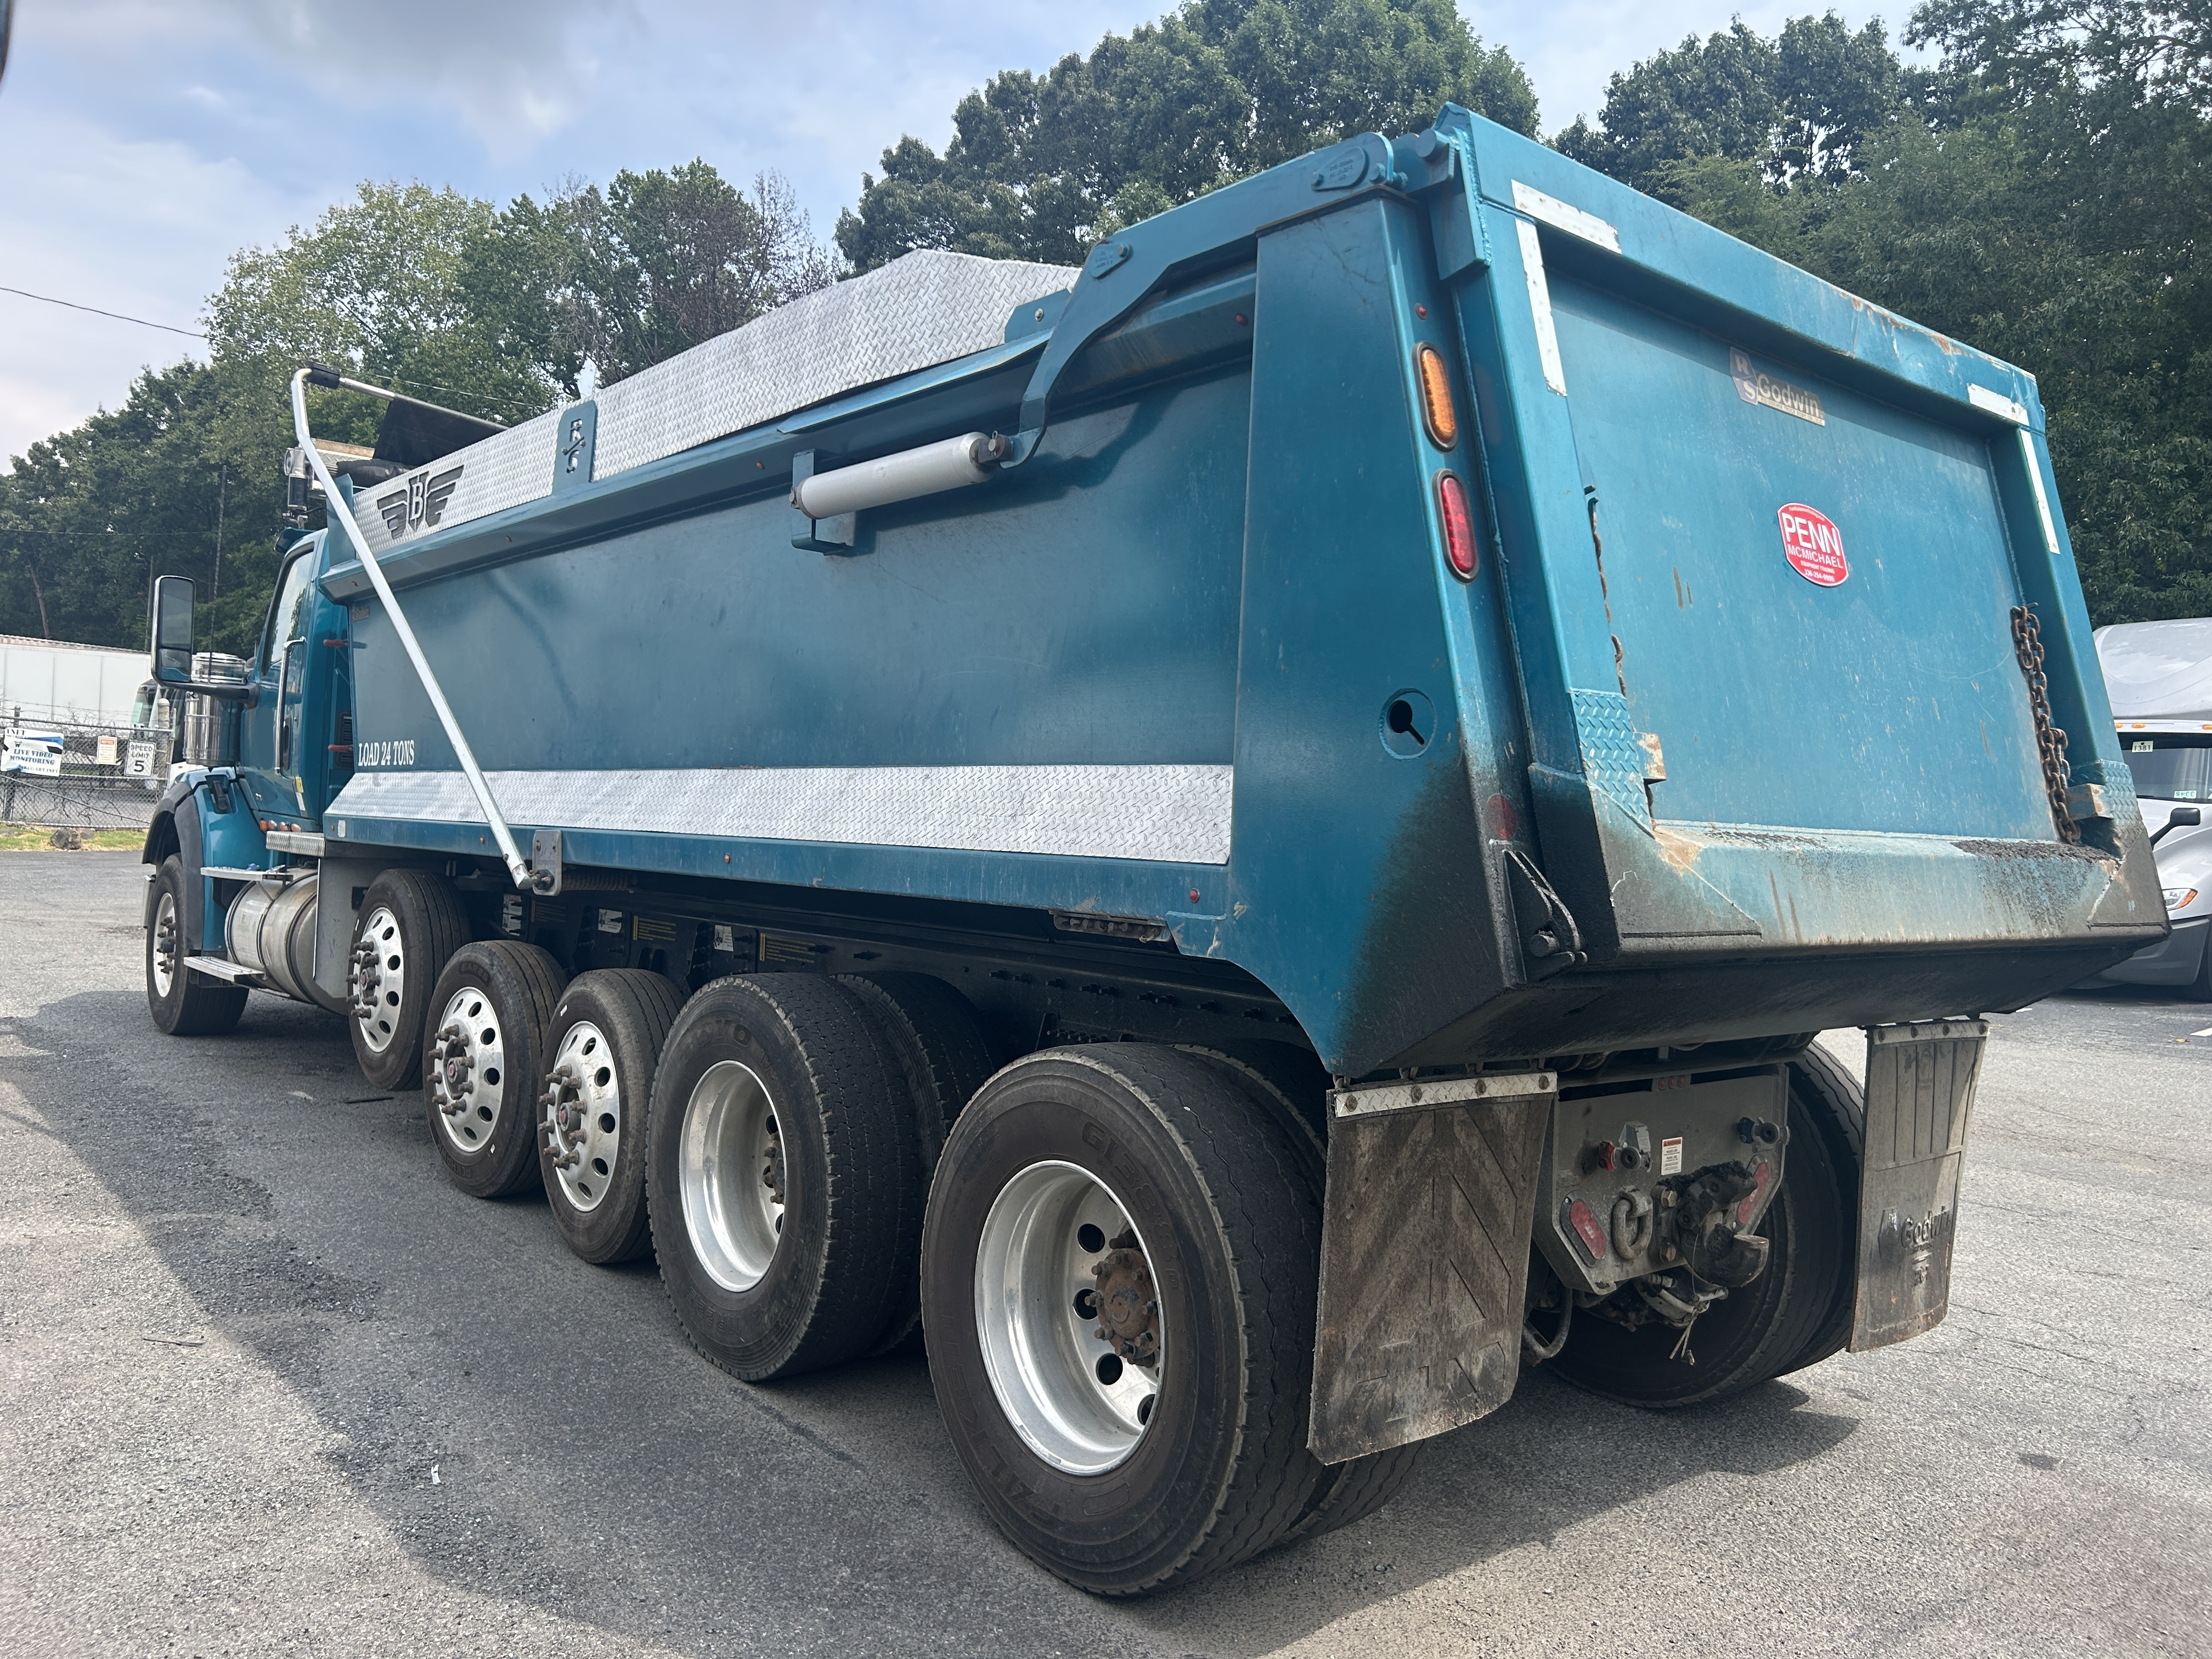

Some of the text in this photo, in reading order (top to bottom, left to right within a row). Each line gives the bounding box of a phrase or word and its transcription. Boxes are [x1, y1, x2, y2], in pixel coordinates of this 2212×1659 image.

[1758, 374, 1820, 417] Godwin
[1781, 512, 1841, 557] PENN
[1787, 544, 1844, 569] MCMICHAEL
[9, 755, 55, 765] MONITORING
[133, 760, 145, 772] 5
[358, 740, 415, 767] LOAD 24 TONS
